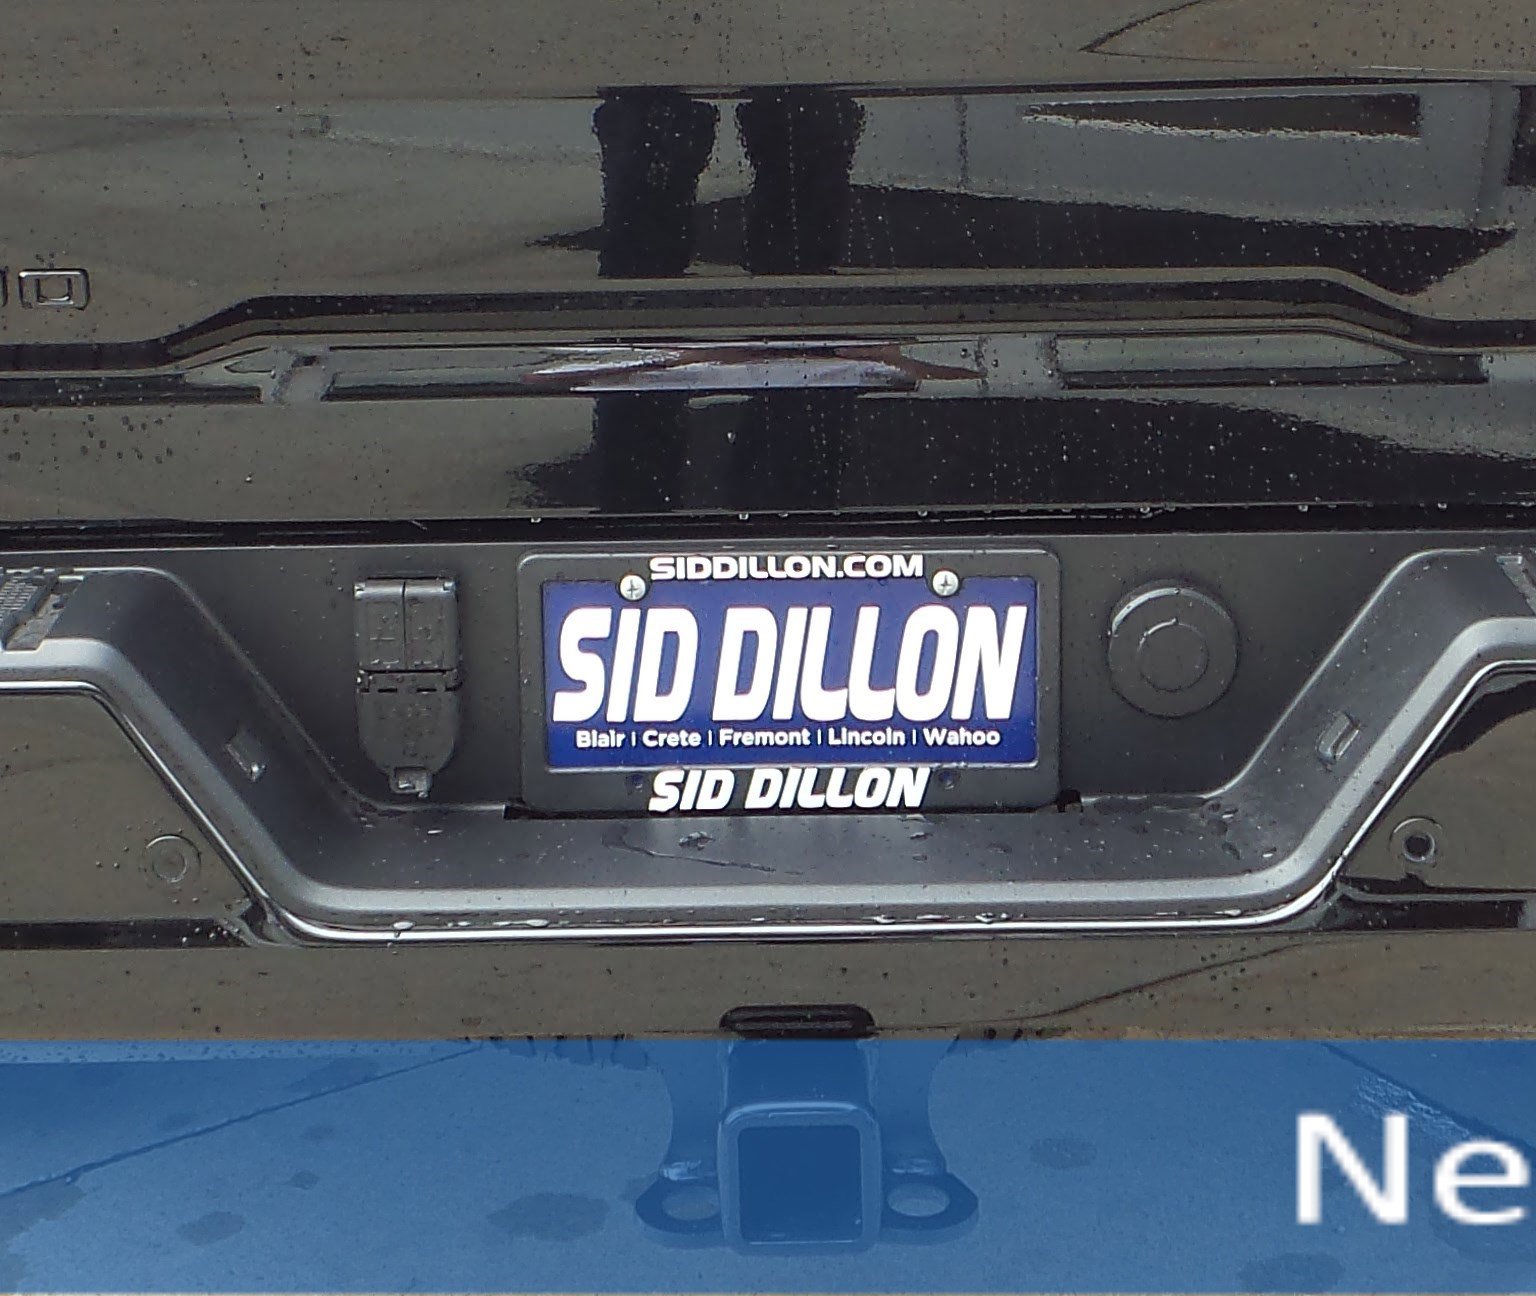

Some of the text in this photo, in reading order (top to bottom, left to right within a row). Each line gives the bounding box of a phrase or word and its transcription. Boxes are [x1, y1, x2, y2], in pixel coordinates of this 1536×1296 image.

[649, 554, 924, 580] SIDDILLON.COM
[552, 605, 1028, 722] SID DILLON
[575, 726, 1001, 748] Blair Crete Fremont Lincoln Wahoo
[648, 766, 931, 812] SID DILLON
